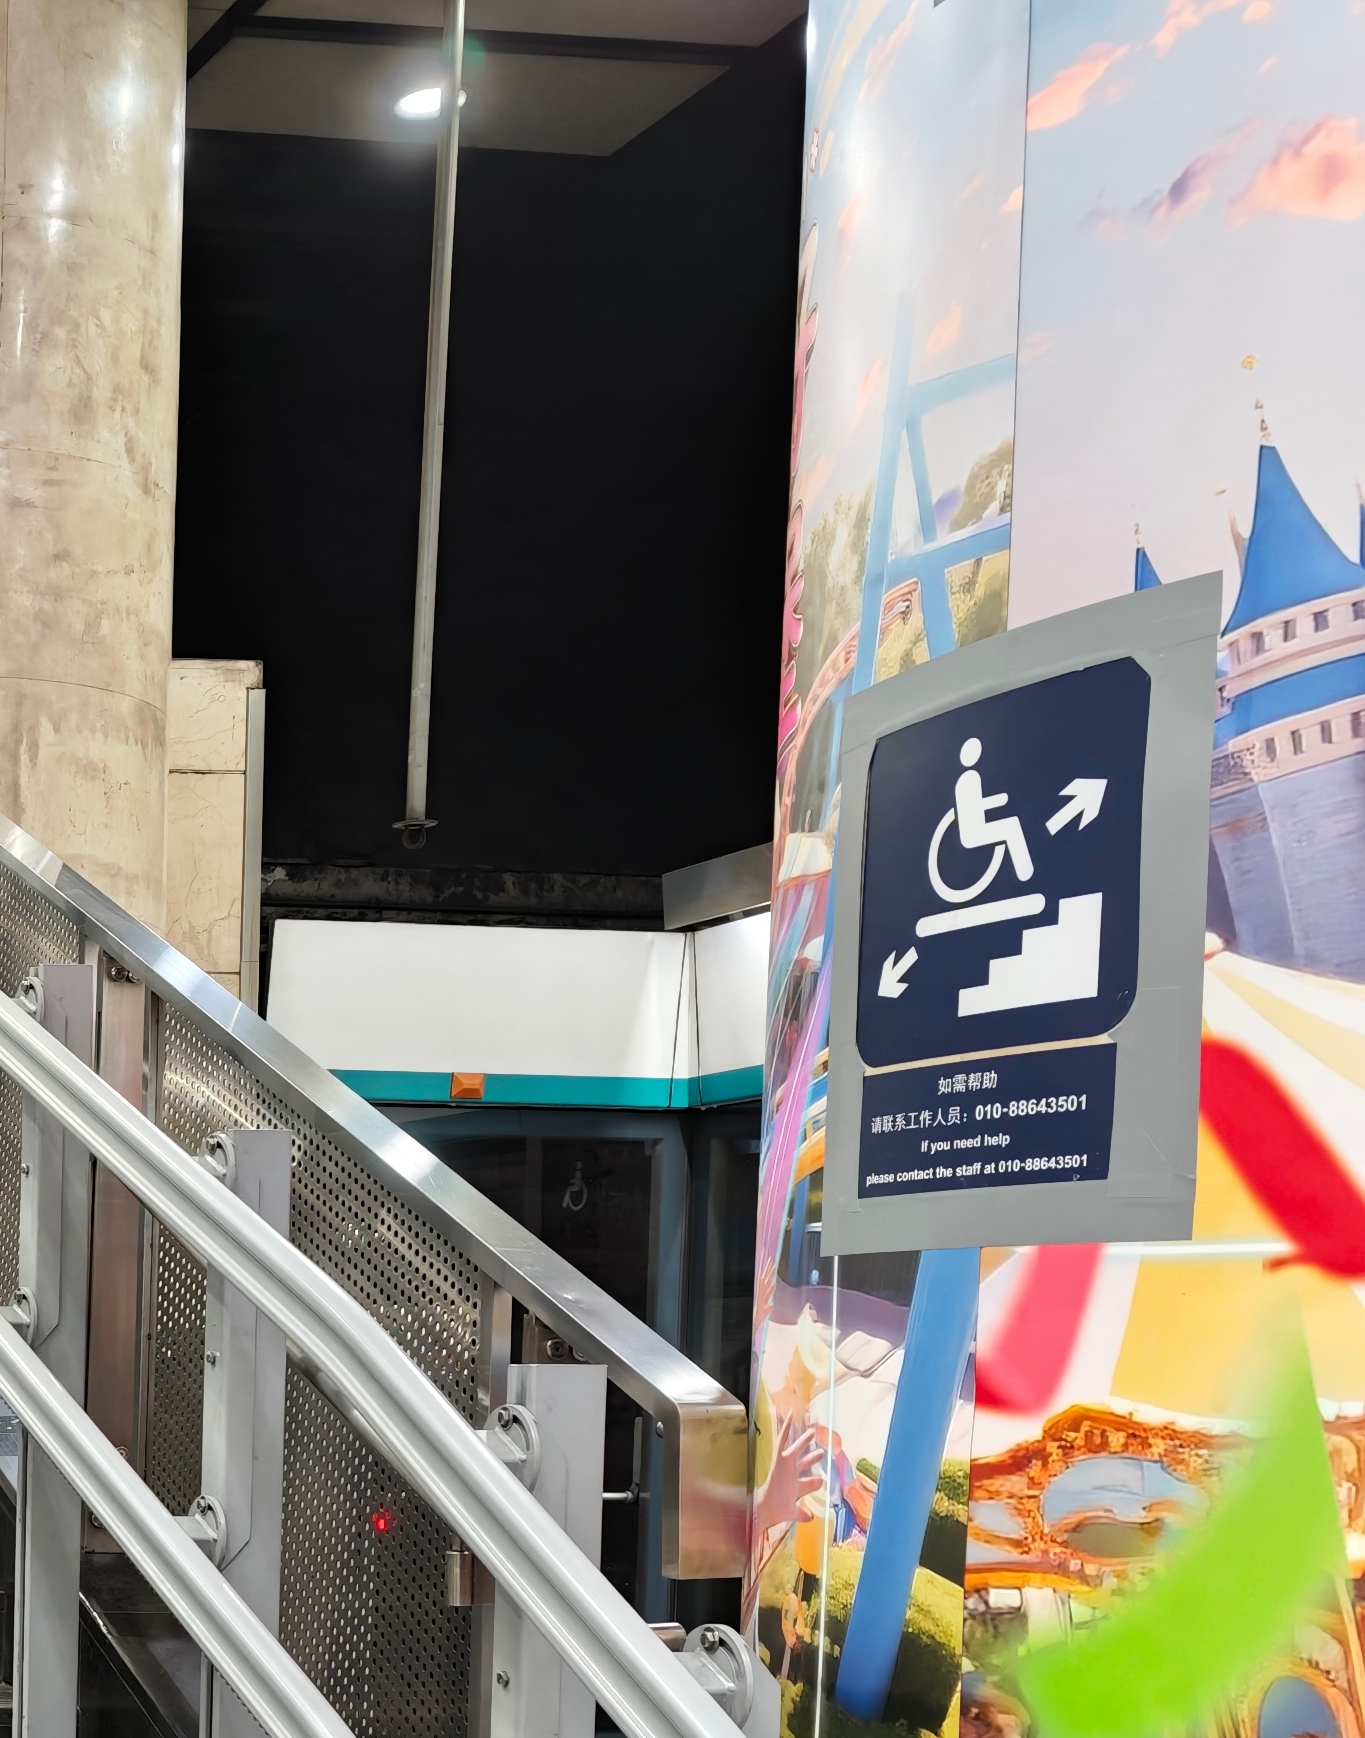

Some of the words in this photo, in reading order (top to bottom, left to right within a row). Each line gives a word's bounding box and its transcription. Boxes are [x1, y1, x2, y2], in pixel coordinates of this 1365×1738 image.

[937, 1070, 998, 1096] 如需帮助
[975, 1094, 1088, 1121] 010-88643501
[930, 1140, 951, 1155] you
[953, 1134, 981, 1150] need
[984, 1132, 1011, 1148] help
[866, 1172, 894, 1188] please
[896, 1167, 934, 1183] contact
[936, 1166, 953, 1178] the
[955, 1162, 981, 1177] staff
[984, 1163, 996, 1175] at
[998, 1154, 1088, 1174] 010-88643501
